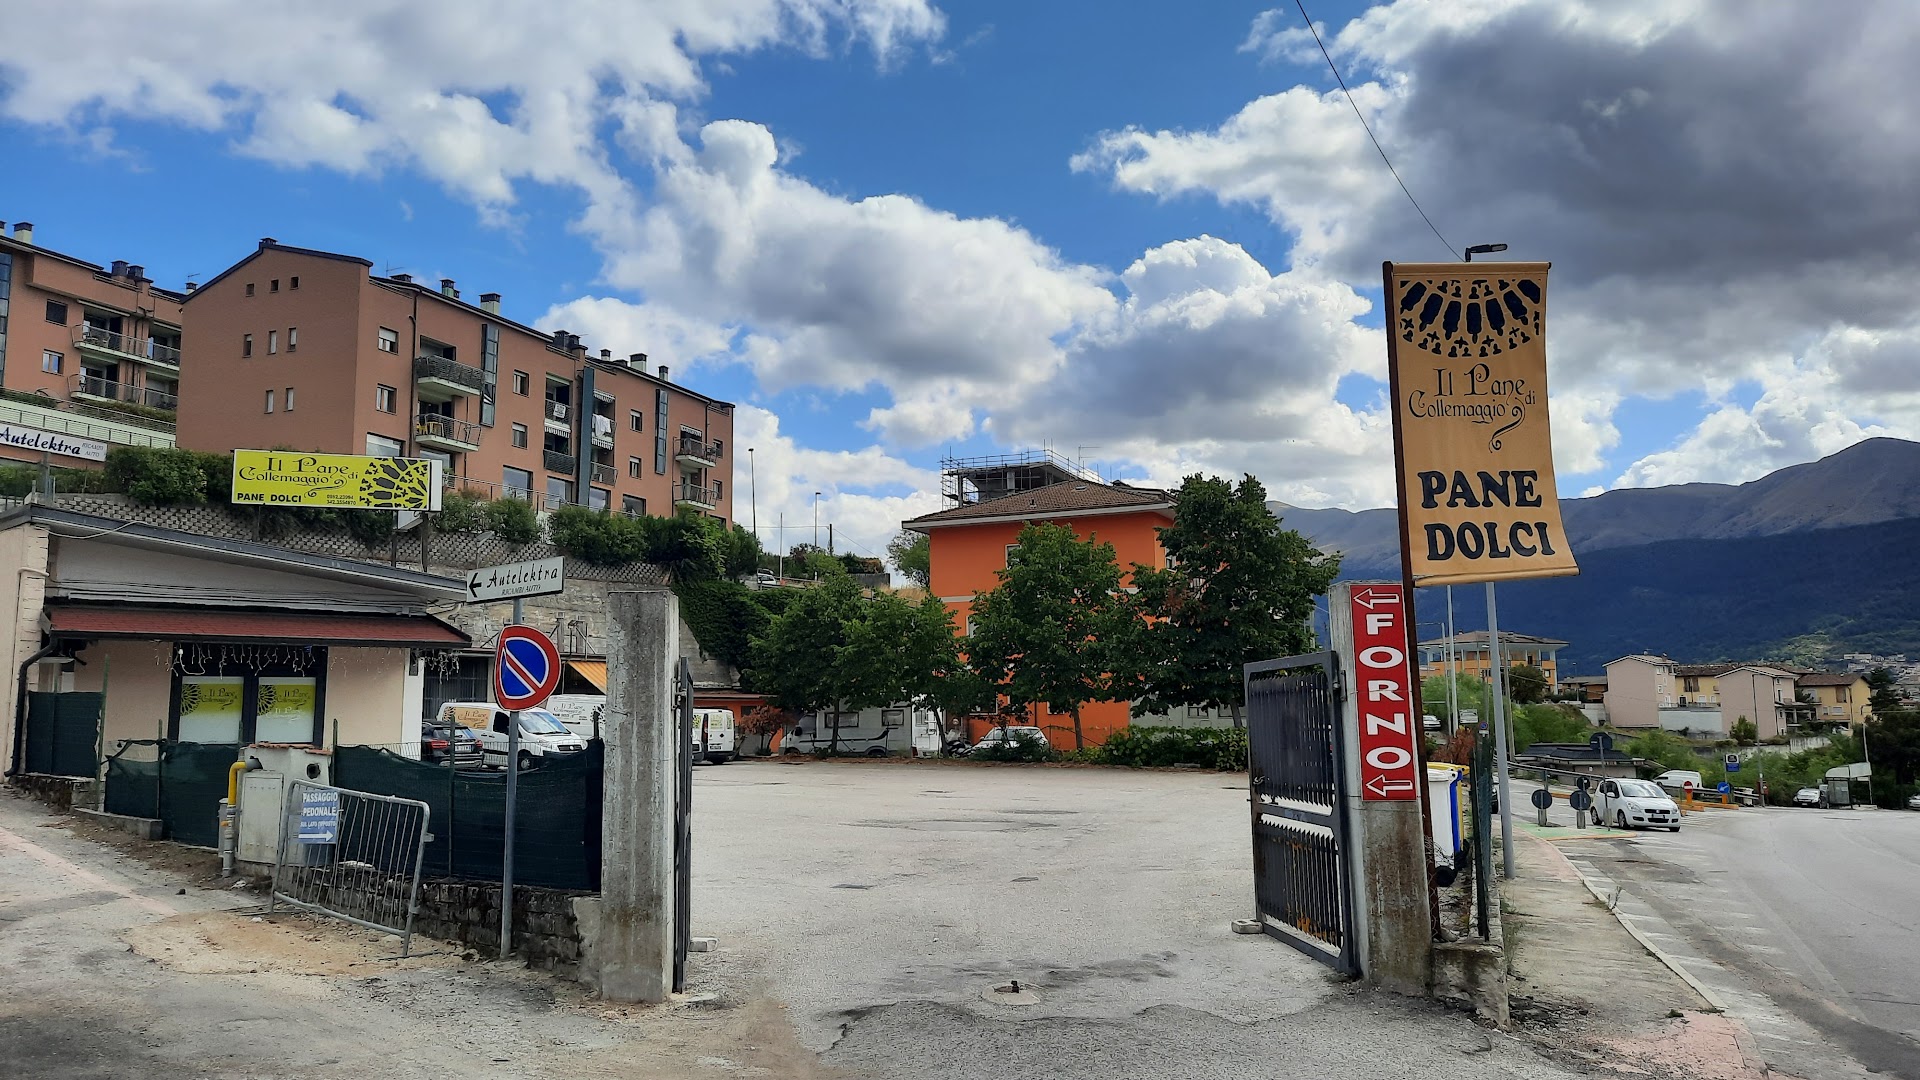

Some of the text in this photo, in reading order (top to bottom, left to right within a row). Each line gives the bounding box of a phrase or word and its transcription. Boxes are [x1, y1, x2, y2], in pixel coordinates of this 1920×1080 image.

[1433, 363, 1536, 406] Il Pane di
[1408, 389, 1506, 424] Collemaggio
[0, 427, 81, 455] Autelektra
[239, 466, 329, 487] Collemaggio
[263, 456, 359, 480] Il Pane di
[237, 492, 302, 503] PANE DOLCI
[1417, 470, 1542, 509] PANE
[1424, 521, 1556, 561] DOLCI
[486, 563, 558, 589] Autelektra
[1358, 613, 1412, 770] FORNO
[303, 792, 338, 803] PASSAGGIO
[303, 807, 337, 817] PEDONALE
